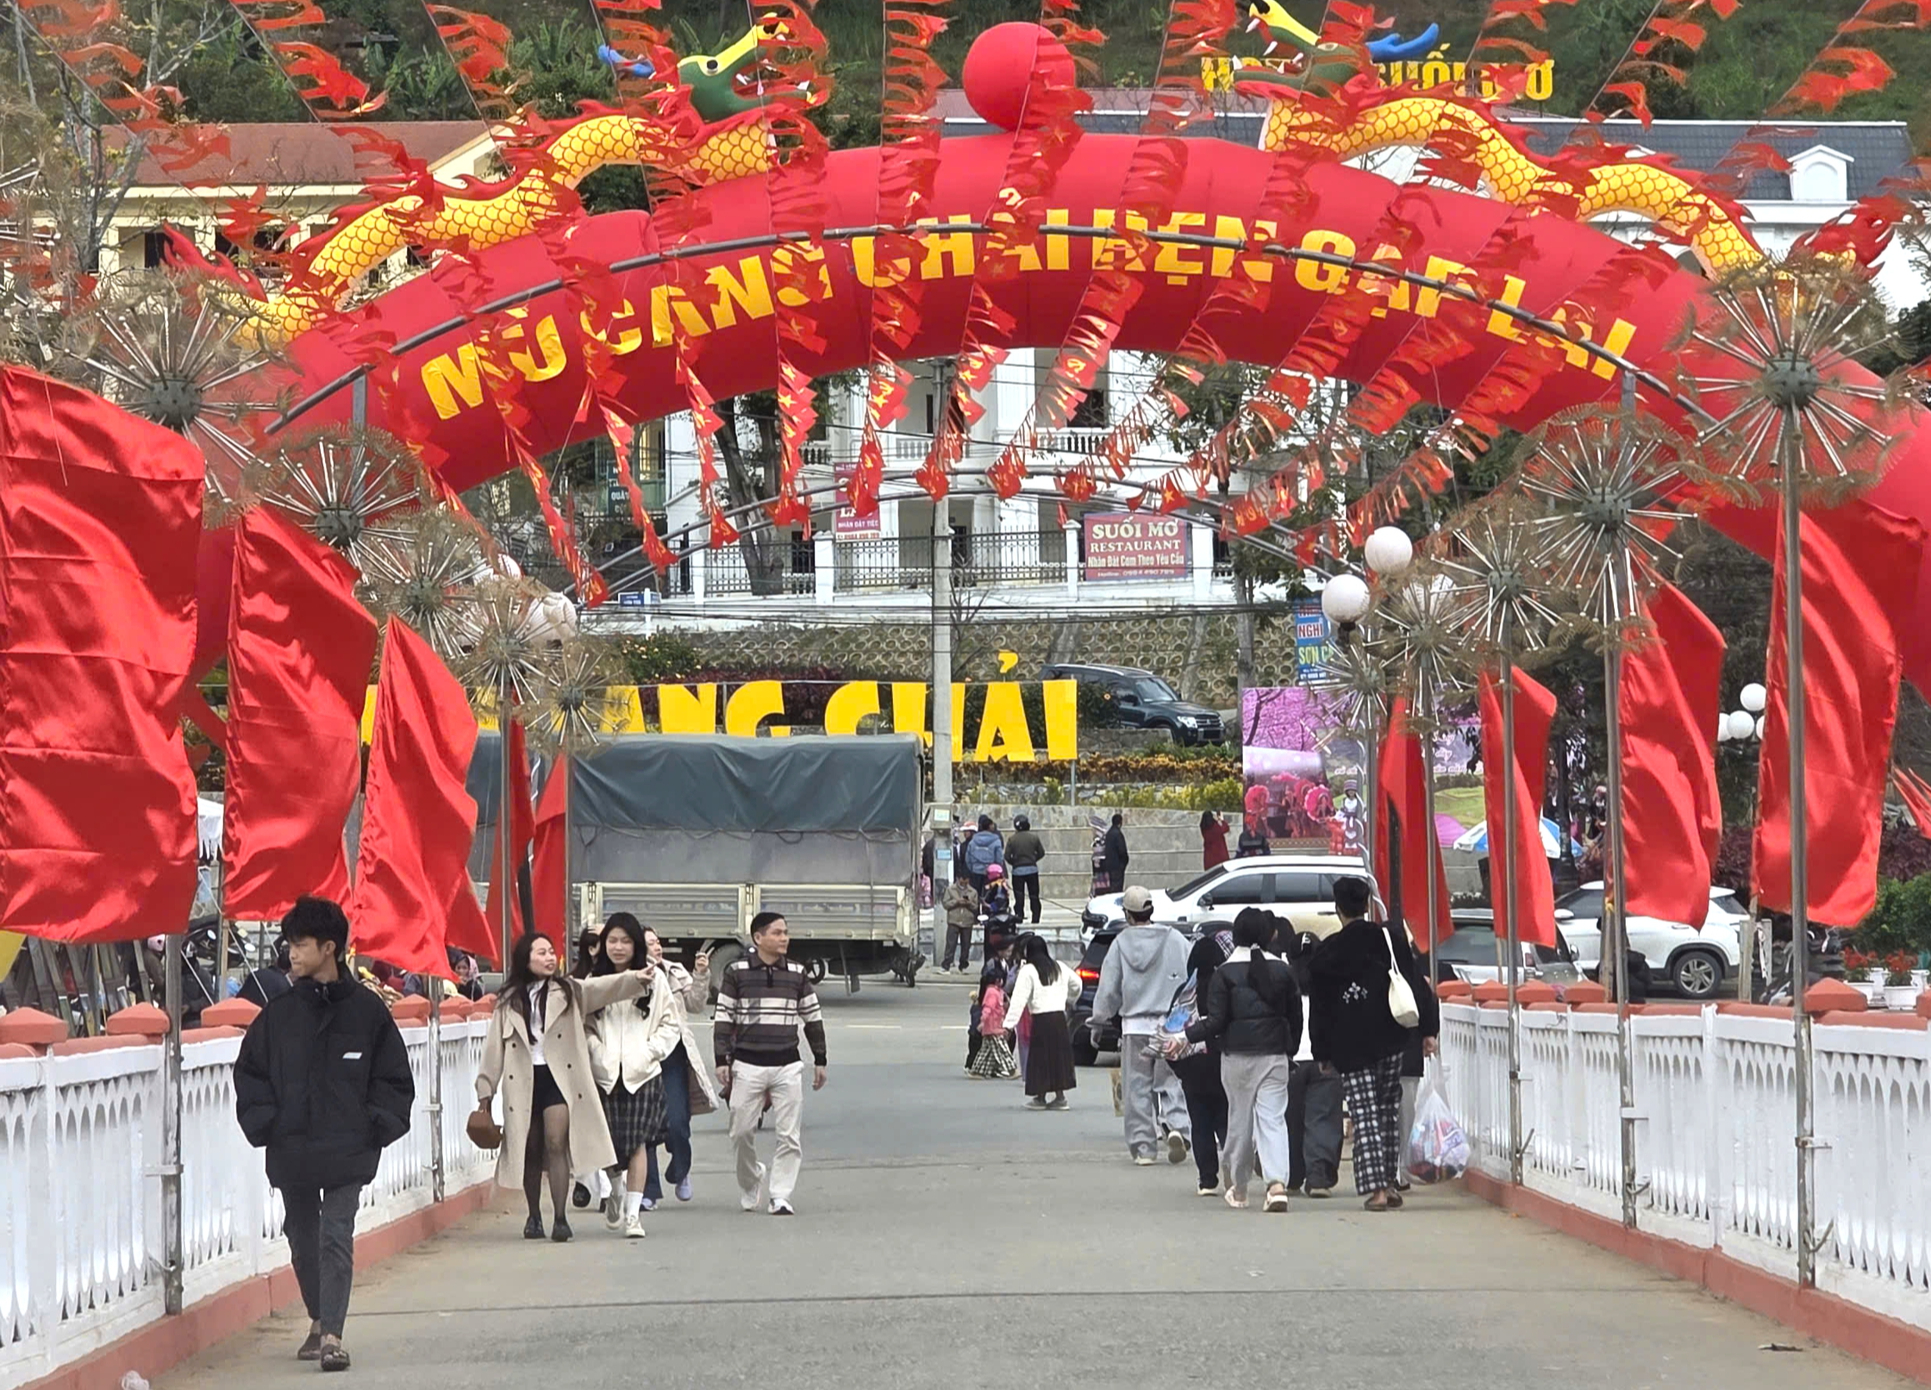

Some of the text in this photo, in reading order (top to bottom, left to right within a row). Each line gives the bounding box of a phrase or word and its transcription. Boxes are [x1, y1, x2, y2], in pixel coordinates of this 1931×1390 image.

[1092, 516, 1178, 539] SUỐI MƠ
[1090, 540, 1181, 553] RESTAURANT
